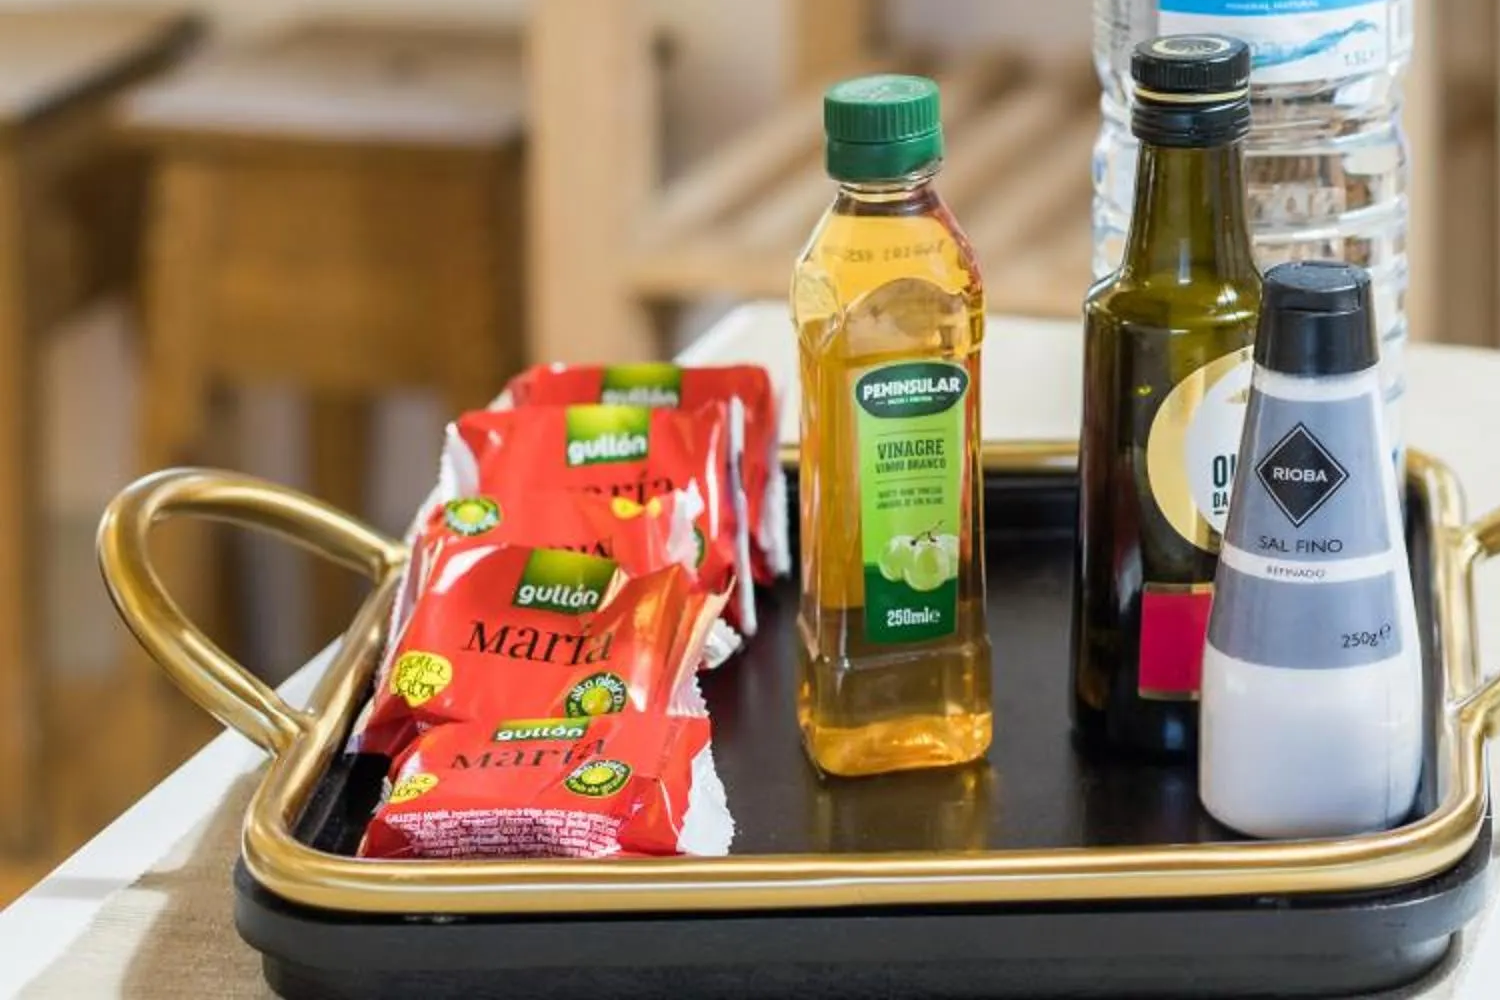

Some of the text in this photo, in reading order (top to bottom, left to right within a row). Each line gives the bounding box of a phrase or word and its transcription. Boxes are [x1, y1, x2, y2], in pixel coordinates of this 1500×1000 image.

[863, 377, 962, 401] PENINSULAR
[567, 432, 648, 466] gullón
[877, 438, 945, 460] VINAGRE
[1273, 466, 1329, 483] RIOBA
[1258, 535, 1344, 554] SAL FINO
[517, 582, 600, 608] gullón
[461, 619, 614, 667] María
[496, 724, 585, 741] gullón
